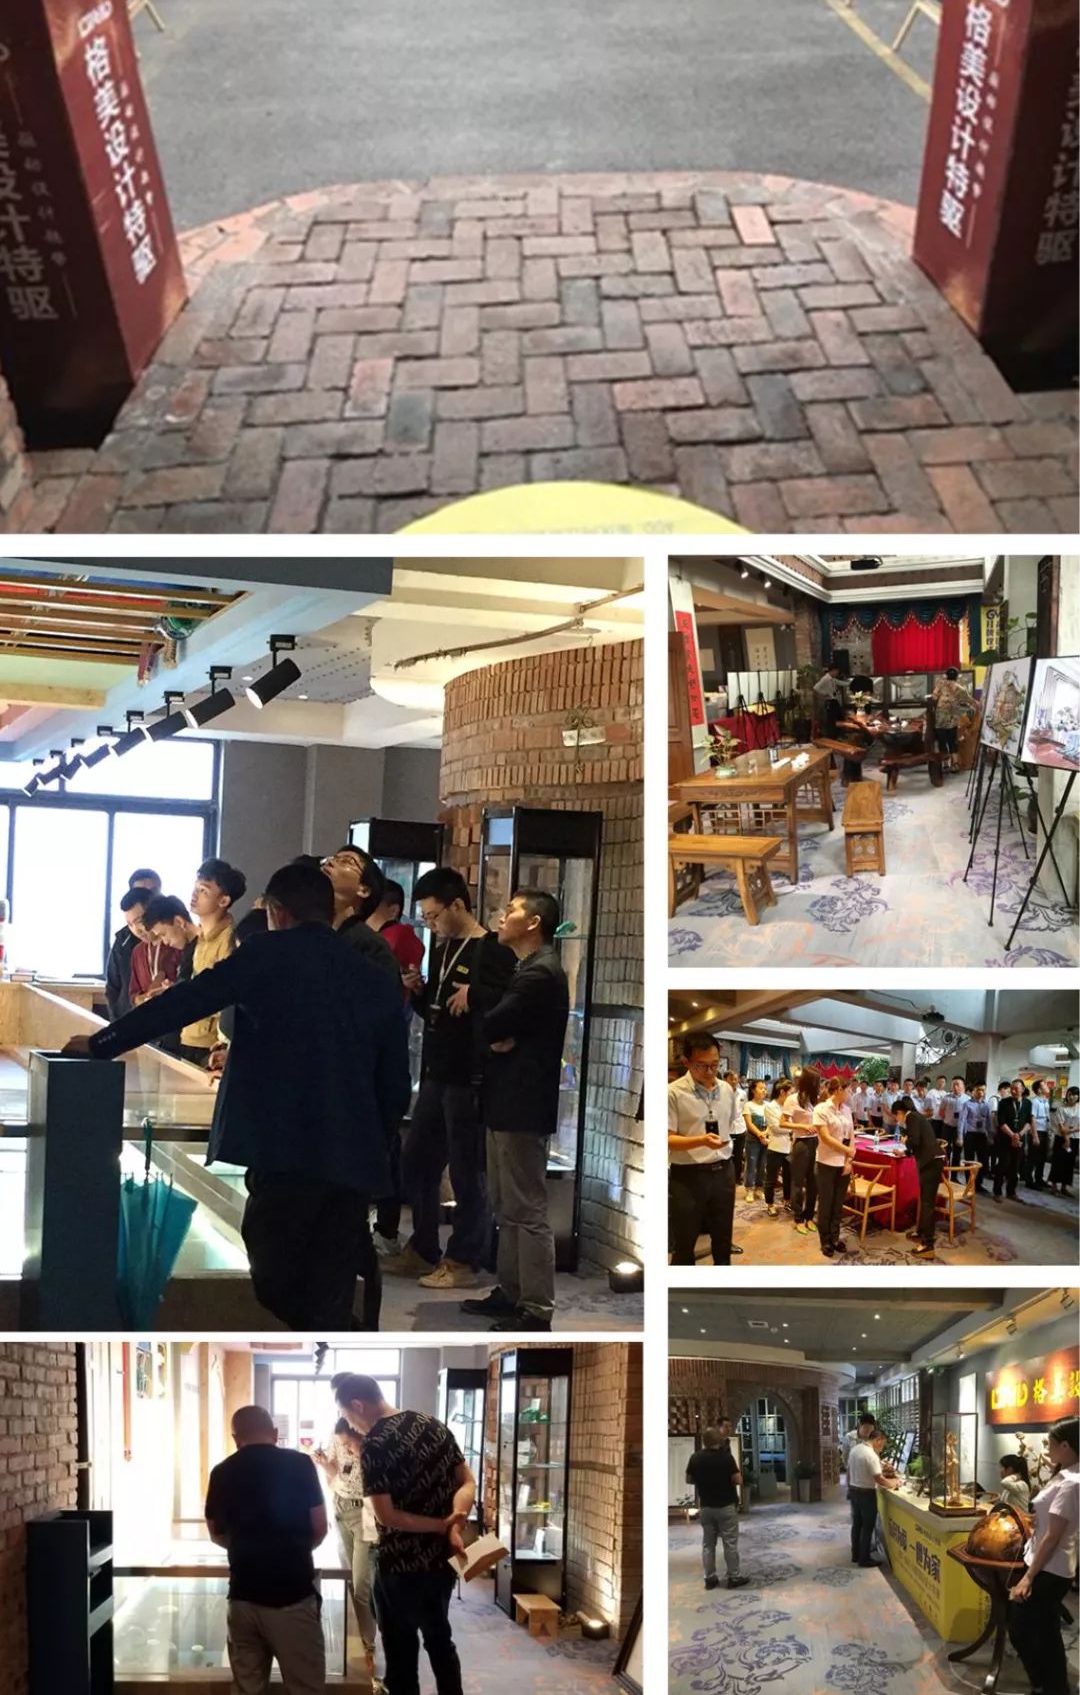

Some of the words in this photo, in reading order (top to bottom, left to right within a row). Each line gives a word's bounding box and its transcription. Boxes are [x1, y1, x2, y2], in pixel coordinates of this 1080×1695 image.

[84, 36, 156, 285] 格美设计特驱
[940, 1, 992, 239] 格美设计特驱
